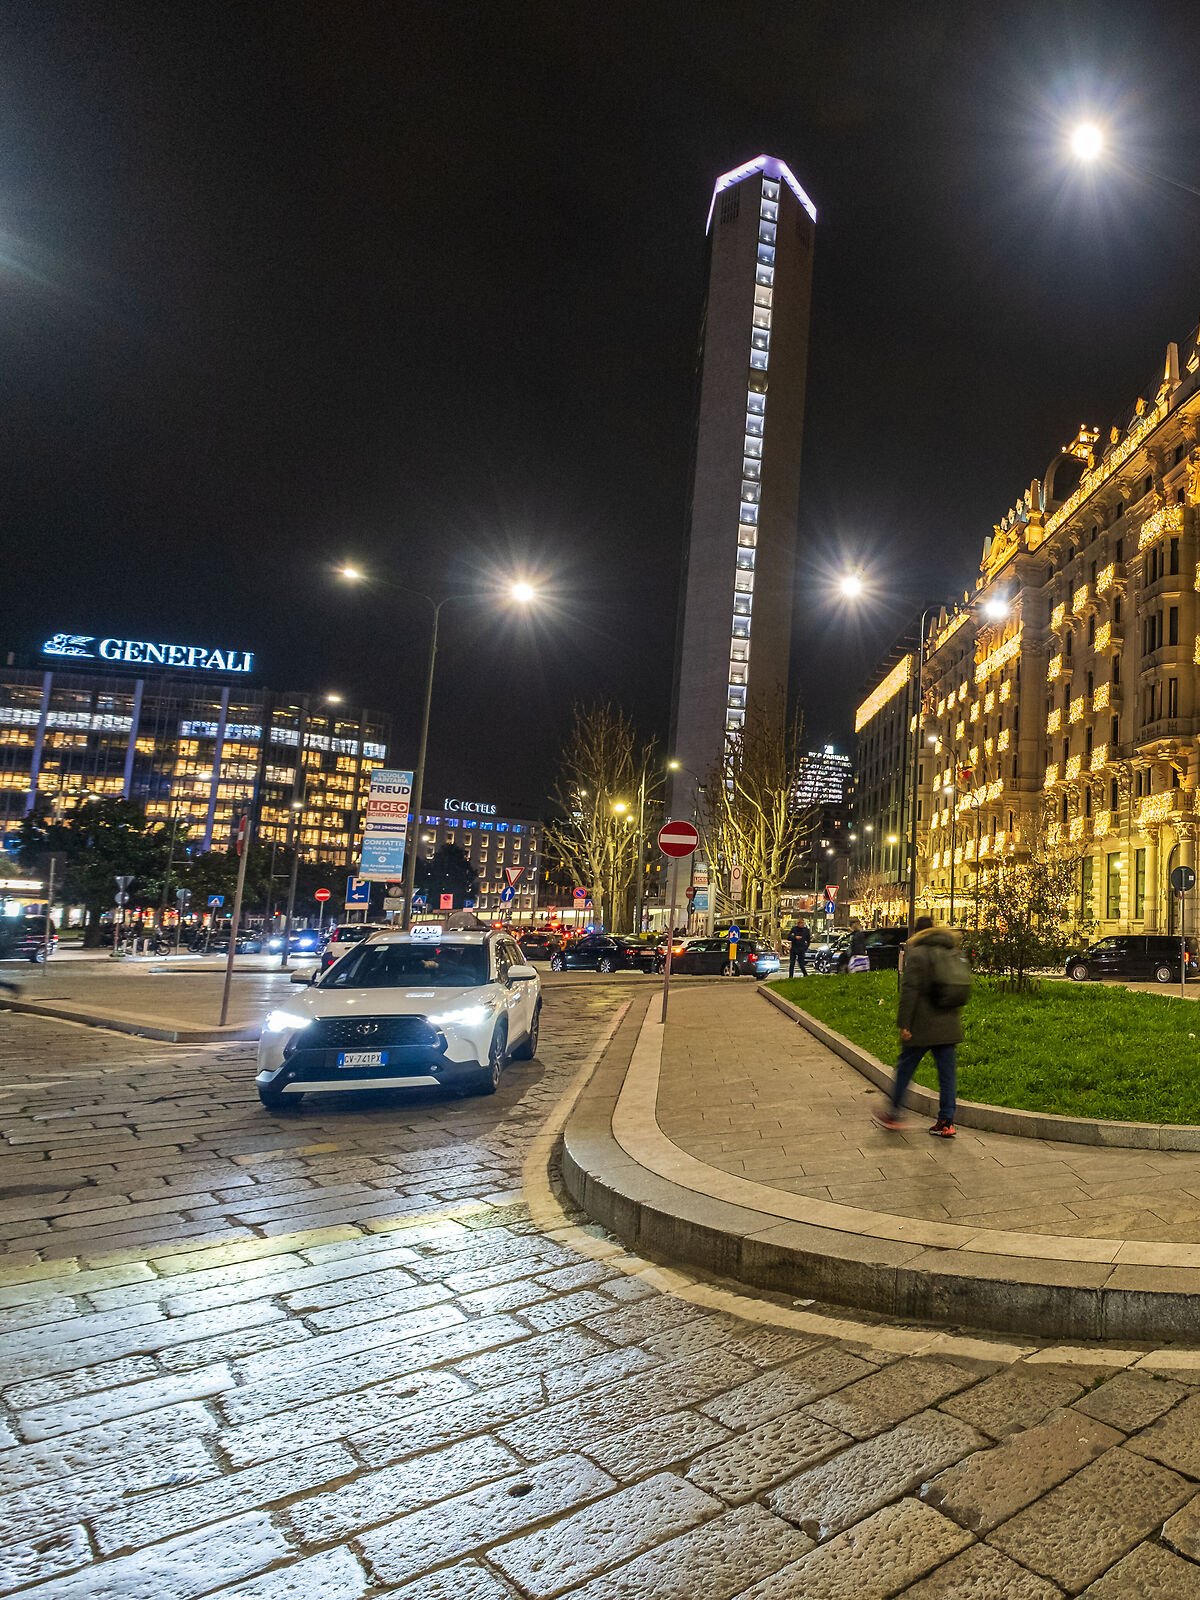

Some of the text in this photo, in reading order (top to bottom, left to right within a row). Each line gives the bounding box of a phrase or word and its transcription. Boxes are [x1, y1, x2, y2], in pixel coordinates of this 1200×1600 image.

[370, 784, 410, 795] FREUD
[369, 801, 407, 812] LICEO
[352, 877, 366, 891] P
